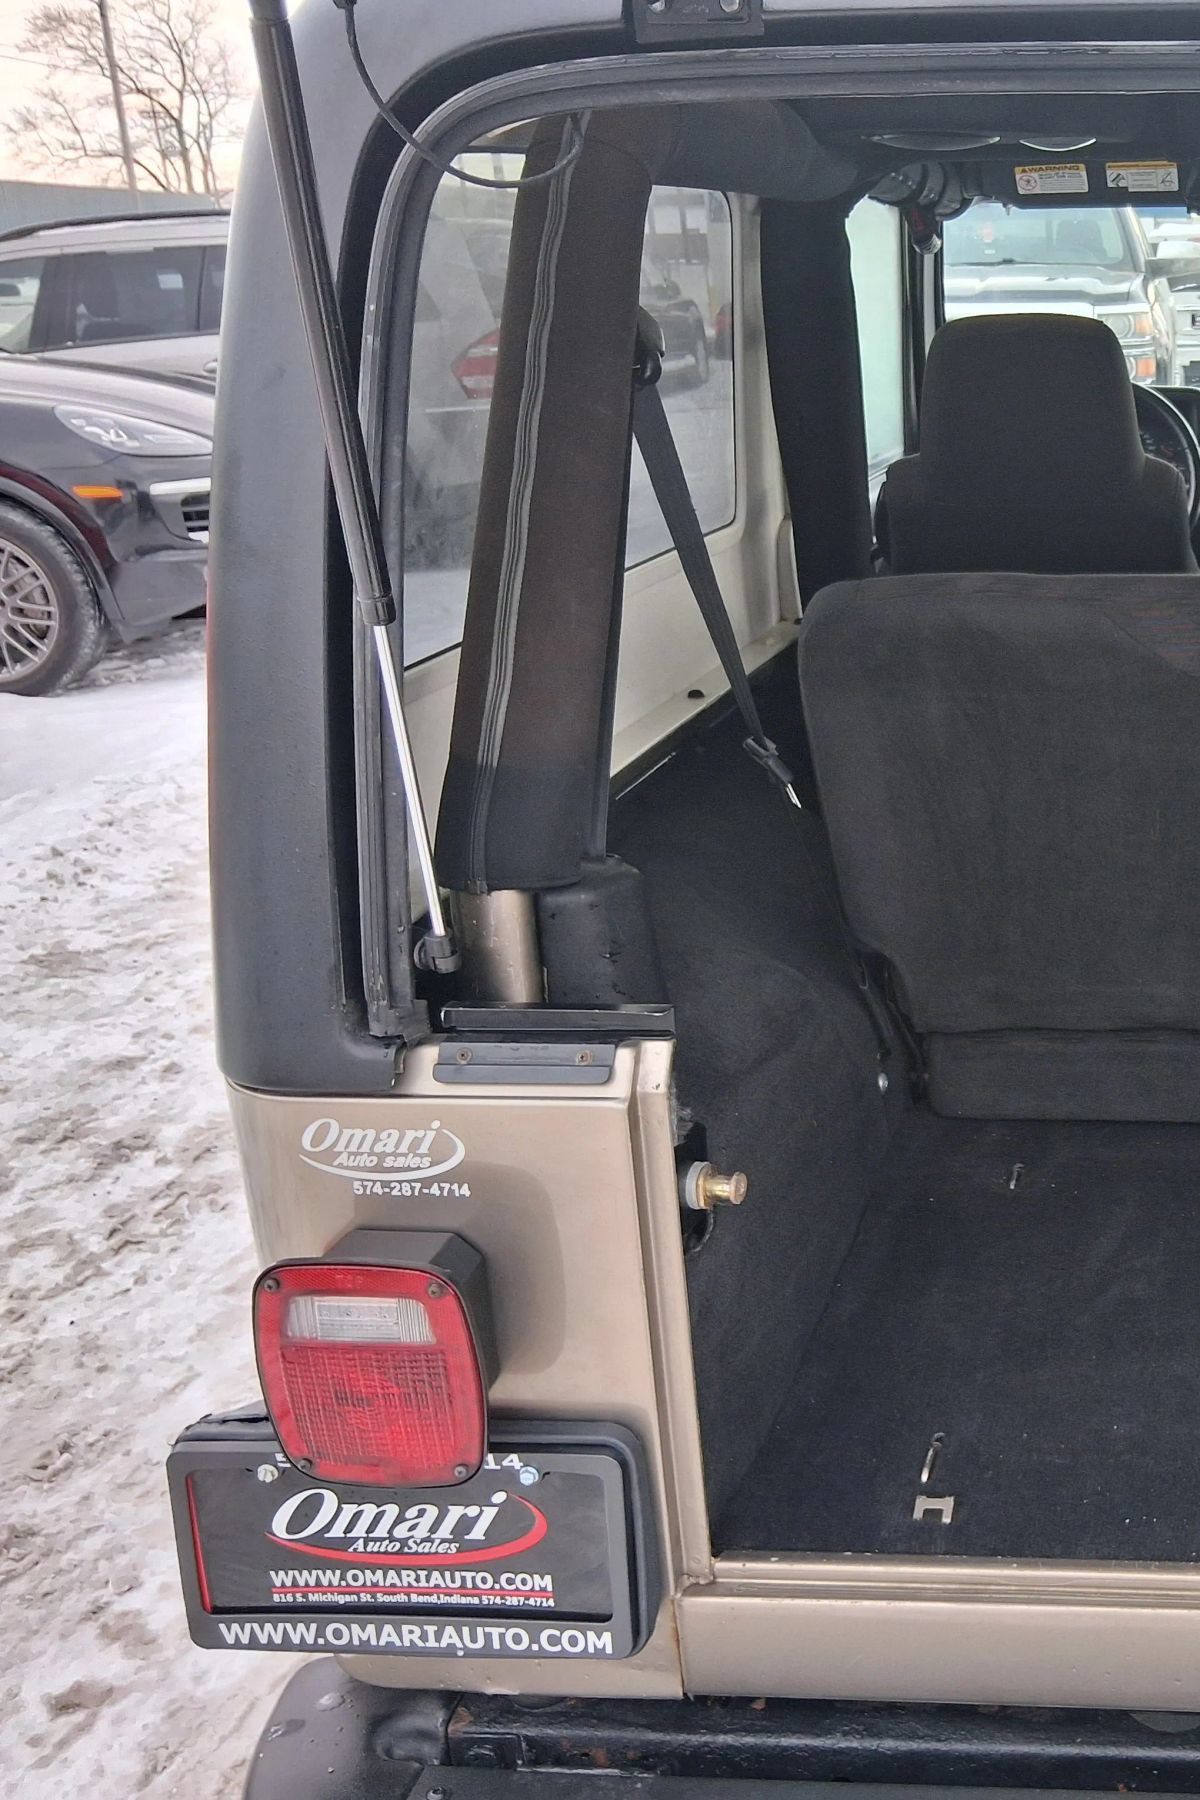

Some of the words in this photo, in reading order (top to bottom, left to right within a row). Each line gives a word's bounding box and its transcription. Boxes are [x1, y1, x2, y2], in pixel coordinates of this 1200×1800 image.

[301, 1118, 441, 1154] Omari
[333, 1152, 379, 1168] Auto
[383, 1153, 432, 1169] sales
[353, 1180, 471, 1198] 574-287-4714
[271, 1488, 508, 1540] Omari
[347, 1538, 402, 1553] Auto
[404, 1538, 460, 1554] Sales
[269, 1569, 553, 1592] WWW.OMARIAUTO.COM
[296, 1593, 306, 1603] S.
[308, 1592, 358, 1604] Michigan
[360, 1593, 375, 1603] St.
[376, 1593, 409, 1603] South
[482, 1595, 555, 1608] 574-287-4714
[218, 1622, 613, 1655] WWW.OMARIAUTO.COM
